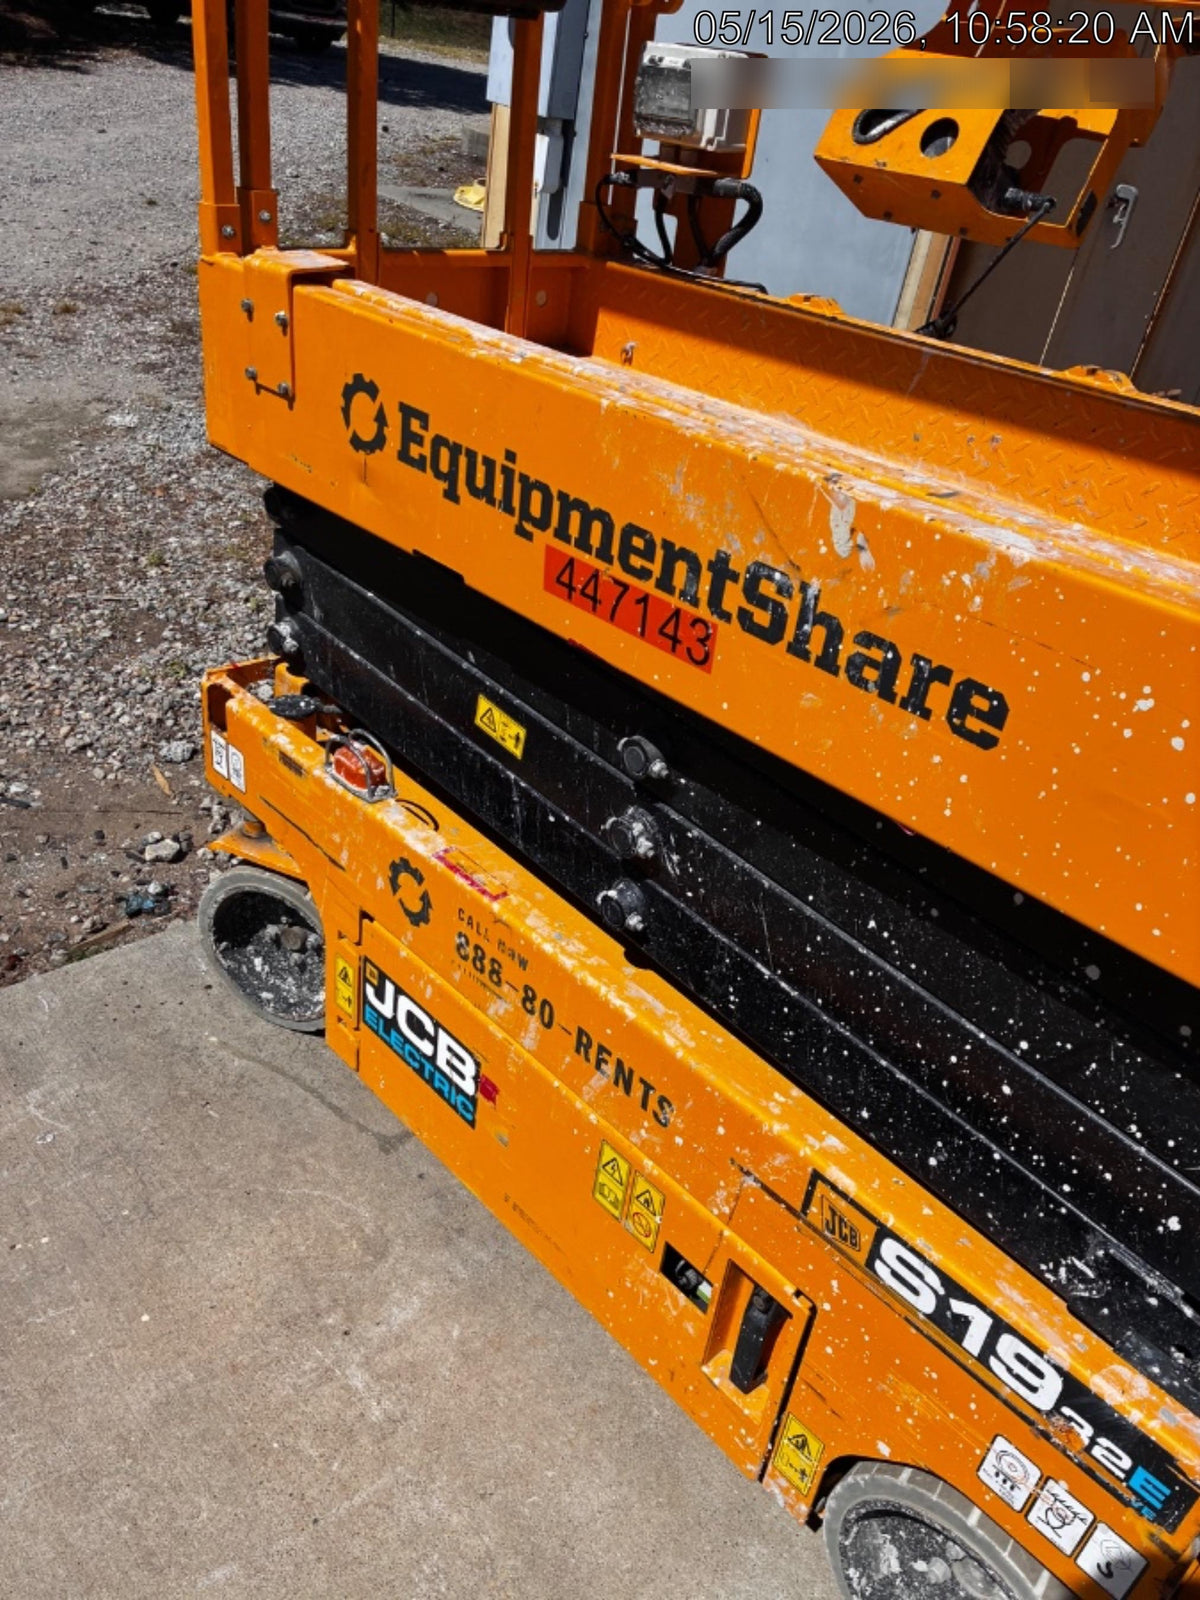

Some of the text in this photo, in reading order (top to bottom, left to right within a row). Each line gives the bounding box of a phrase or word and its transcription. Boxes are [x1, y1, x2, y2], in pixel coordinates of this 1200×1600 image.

[397, 401, 1010, 751] EquipmentShare
[555, 556, 713, 667] 447143
[365, 978, 476, 1097] JCB
[365, 1004, 475, 1121] ELECTRIC
[456, 931, 676, 1128] 888-80-RENTS
[825, 1204, 859, 1248] JCB
